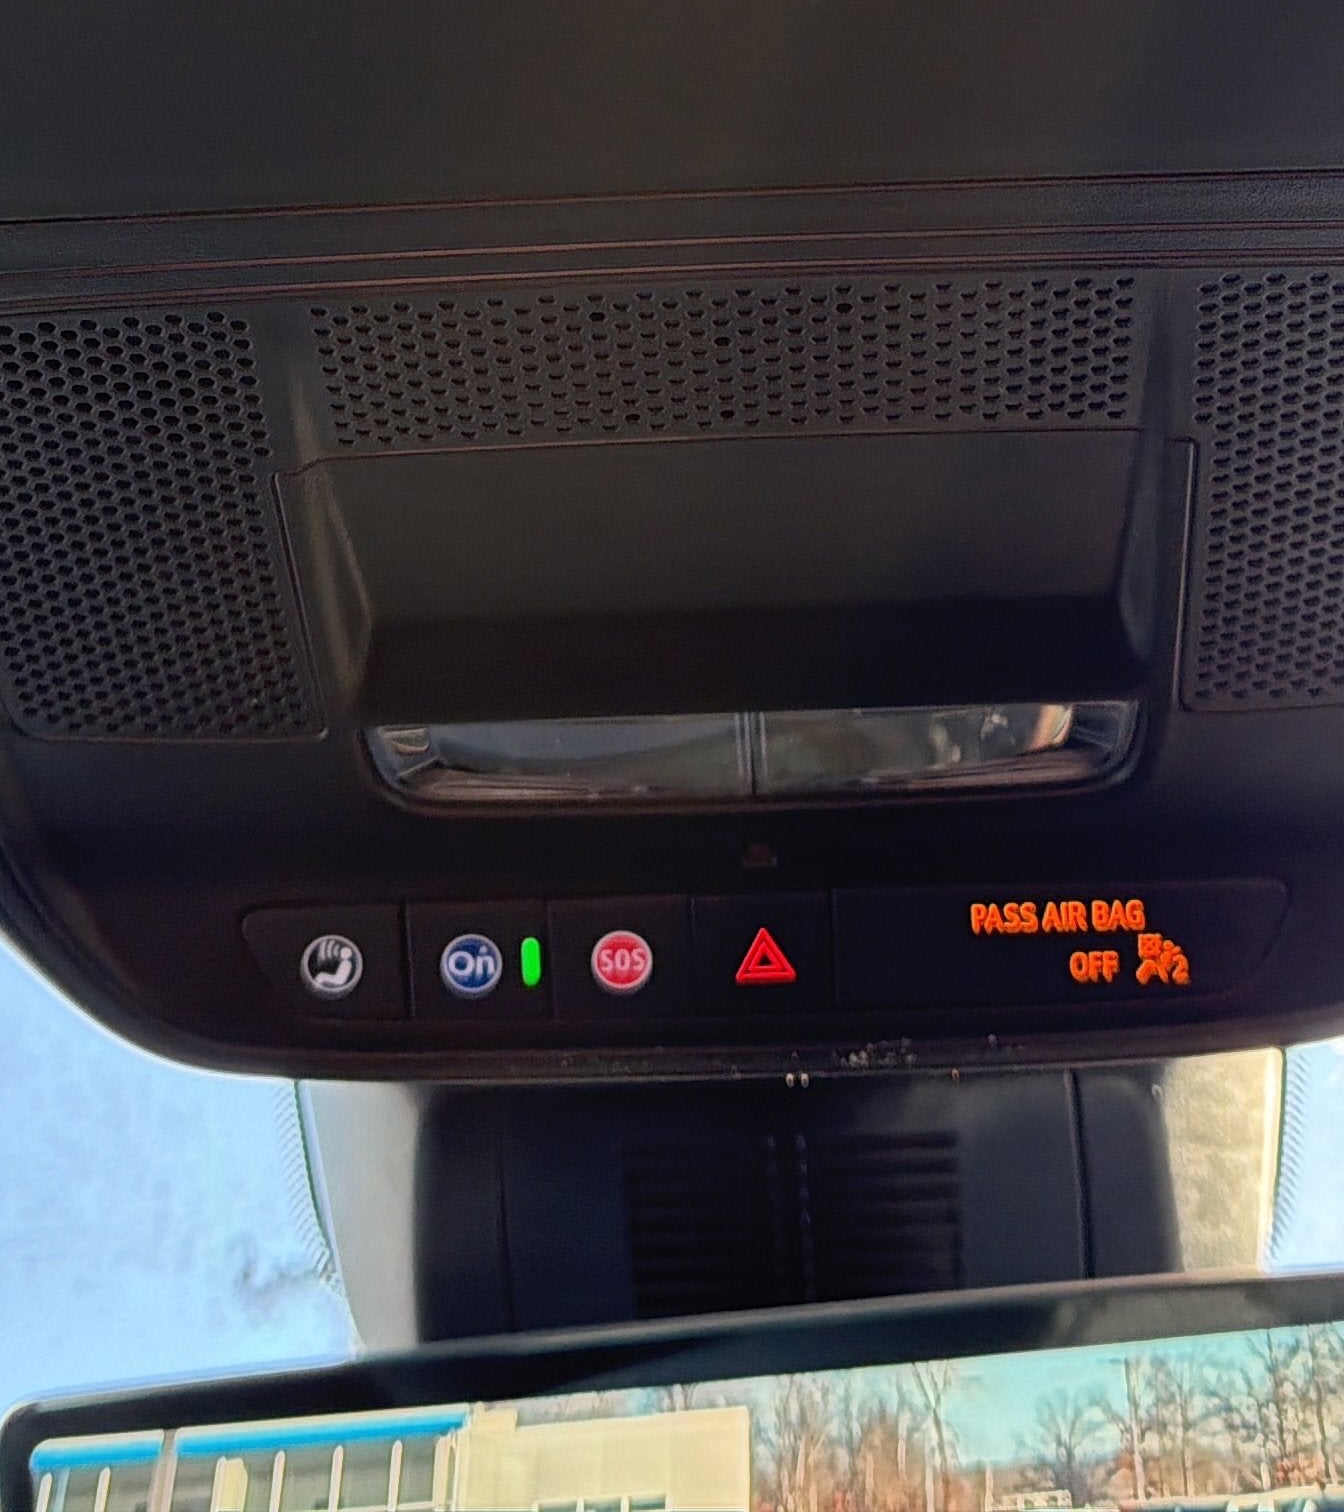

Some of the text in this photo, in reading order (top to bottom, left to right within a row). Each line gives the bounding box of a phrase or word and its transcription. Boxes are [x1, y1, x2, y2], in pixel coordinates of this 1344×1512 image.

[970, 899, 1145, 934] PASS AIR BAG
[448, 945, 495, 977] On
[598, 948, 646, 973] SOS
[1070, 950, 1119, 983] OFF
